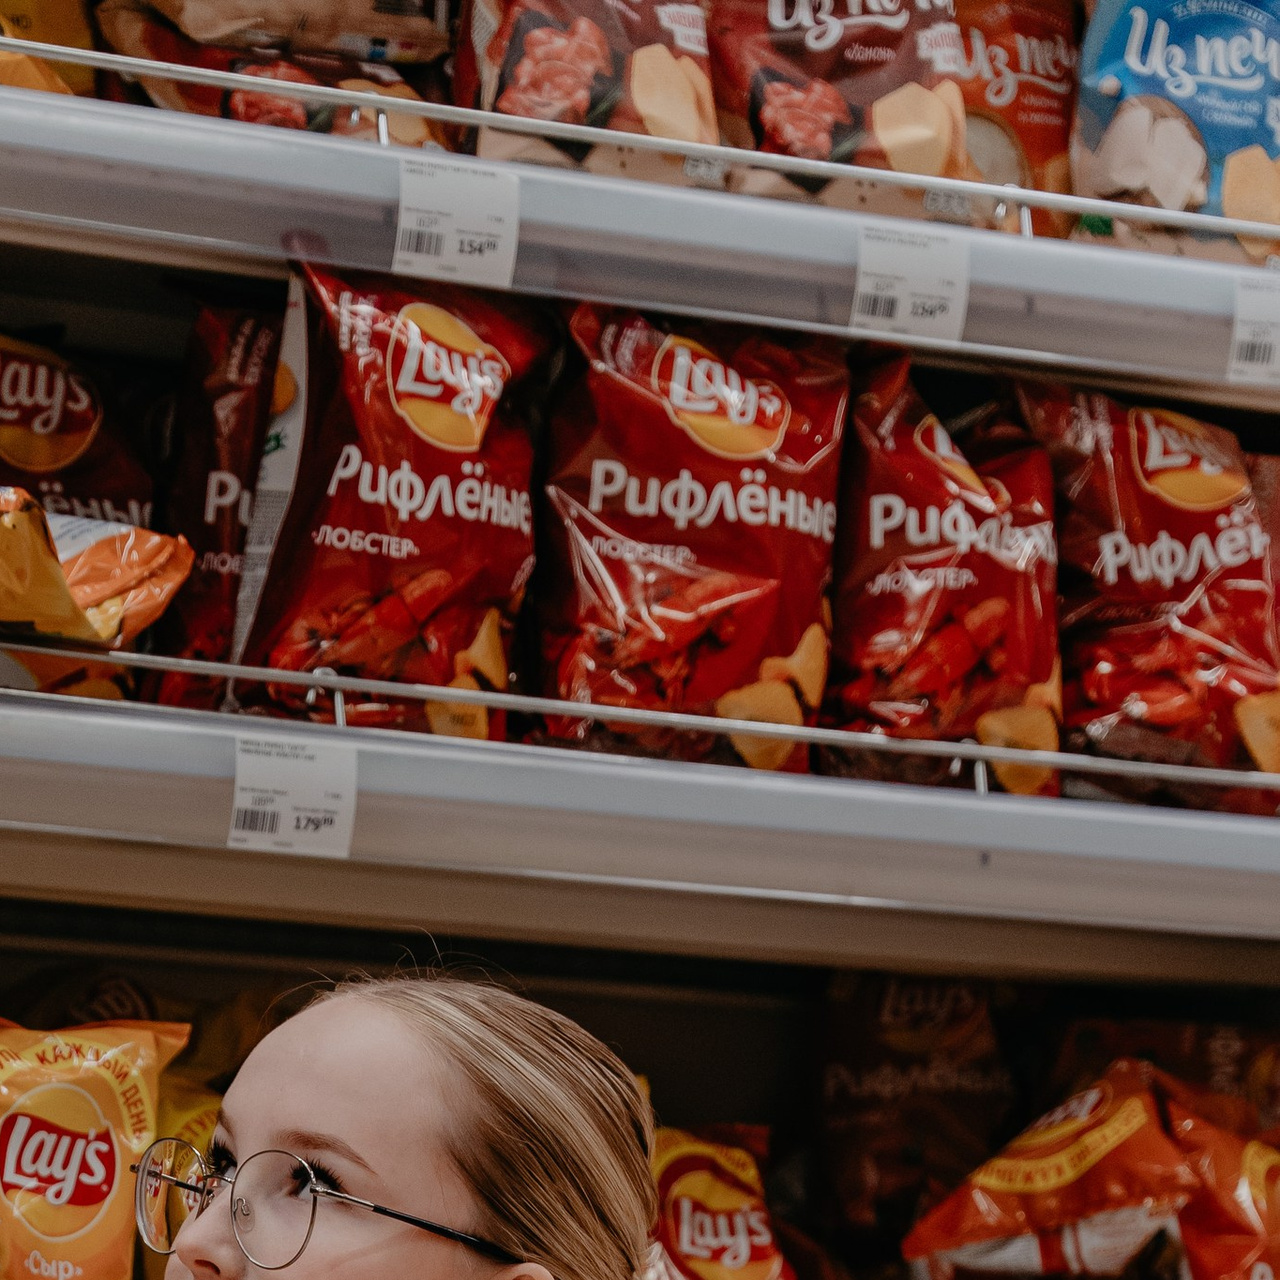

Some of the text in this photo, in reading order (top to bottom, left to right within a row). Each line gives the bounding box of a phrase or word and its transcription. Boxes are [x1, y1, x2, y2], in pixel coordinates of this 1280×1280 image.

[1194, 27, 1280, 81] печ
[589, 459, 837, 542] Рифлёные
[2, 1114, 112, 1206] Lay's
